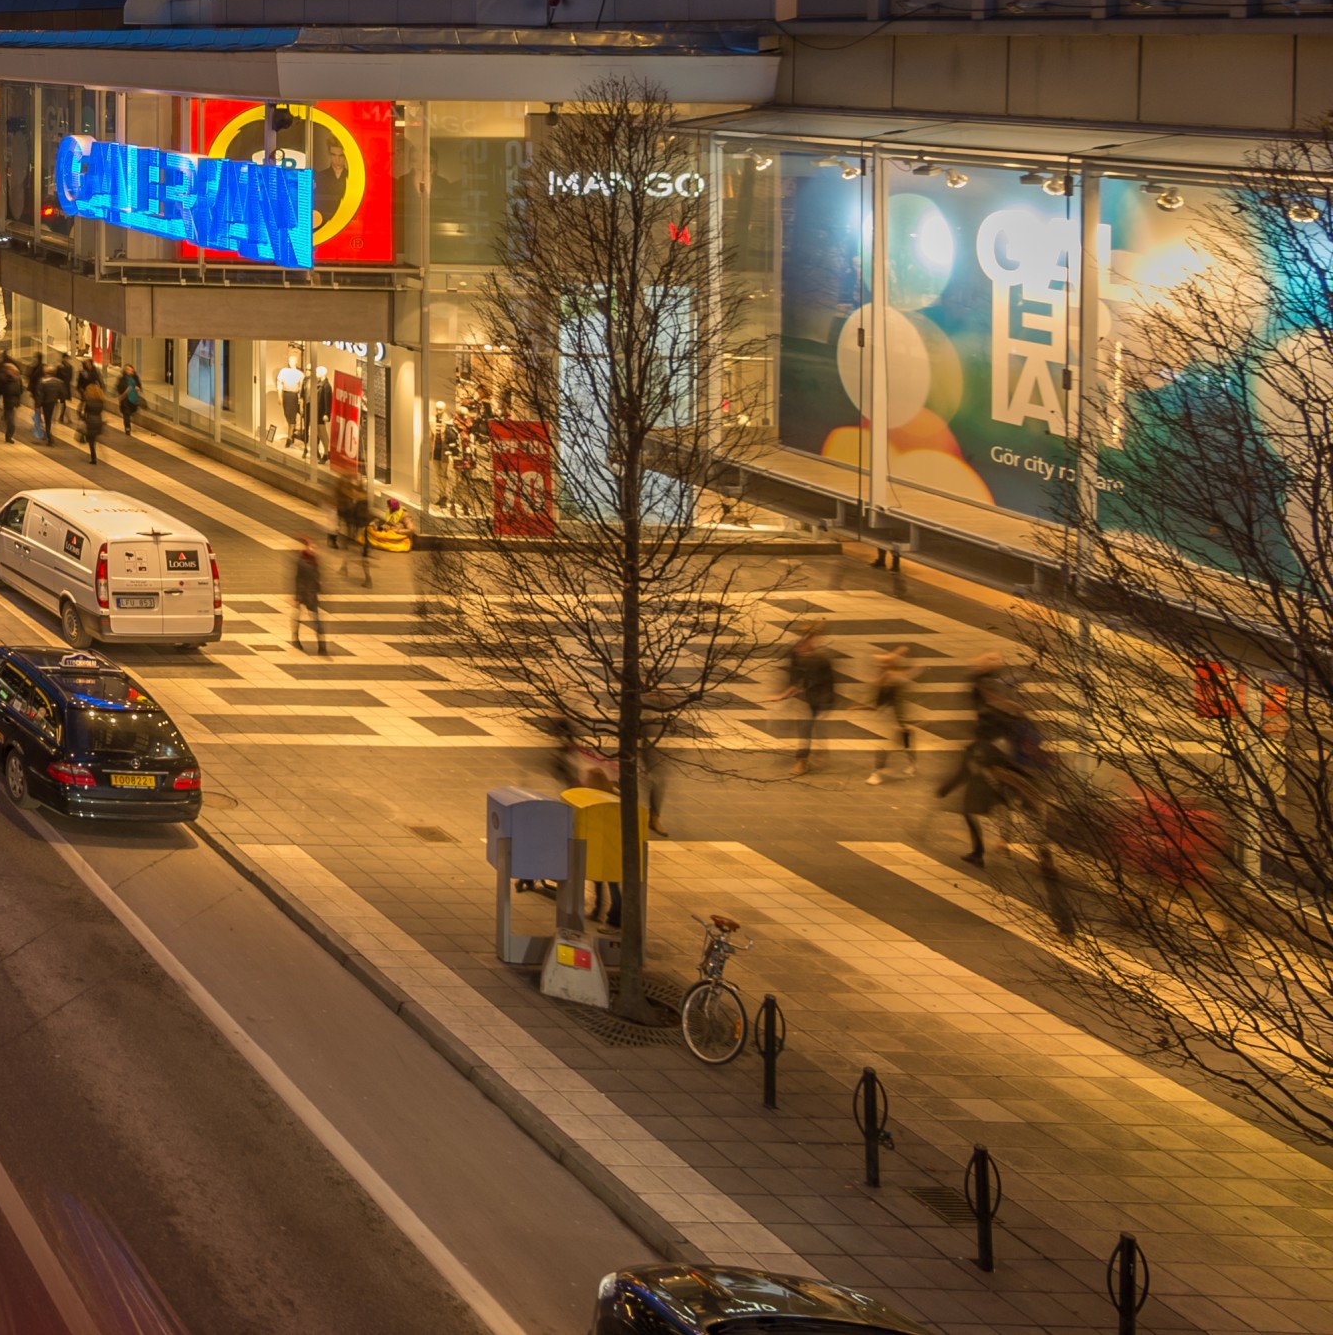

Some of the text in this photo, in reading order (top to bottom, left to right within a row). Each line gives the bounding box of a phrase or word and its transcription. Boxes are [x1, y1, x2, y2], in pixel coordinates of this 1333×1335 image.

[990, 445, 1020, 467] Gör
[1024, 456, 1055, 482] city
[169, 560, 196, 568] LOOMIS
